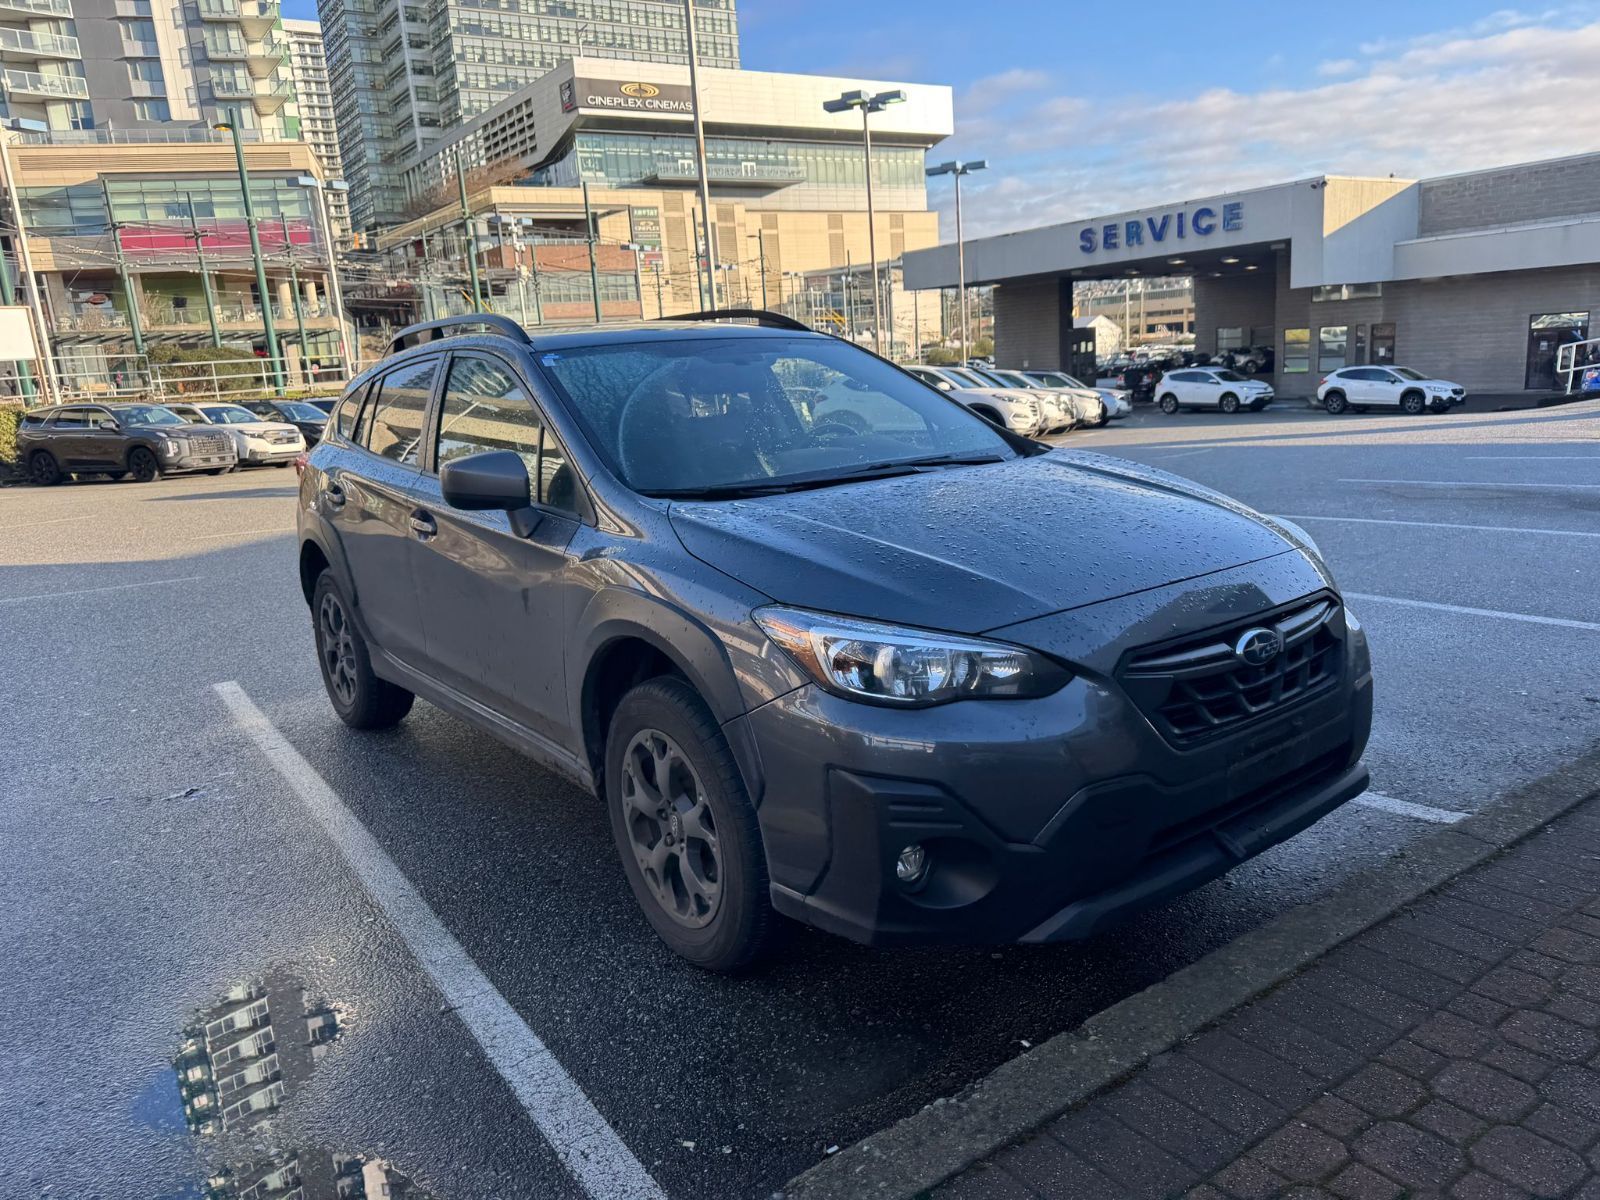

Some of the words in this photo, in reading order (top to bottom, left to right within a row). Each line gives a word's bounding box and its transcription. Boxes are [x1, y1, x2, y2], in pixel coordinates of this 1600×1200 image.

[587, 95, 642, 108] CINEPLEX
[645, 100, 693, 111] CINEMAS
[1079, 202, 1244, 253] SERVICE
